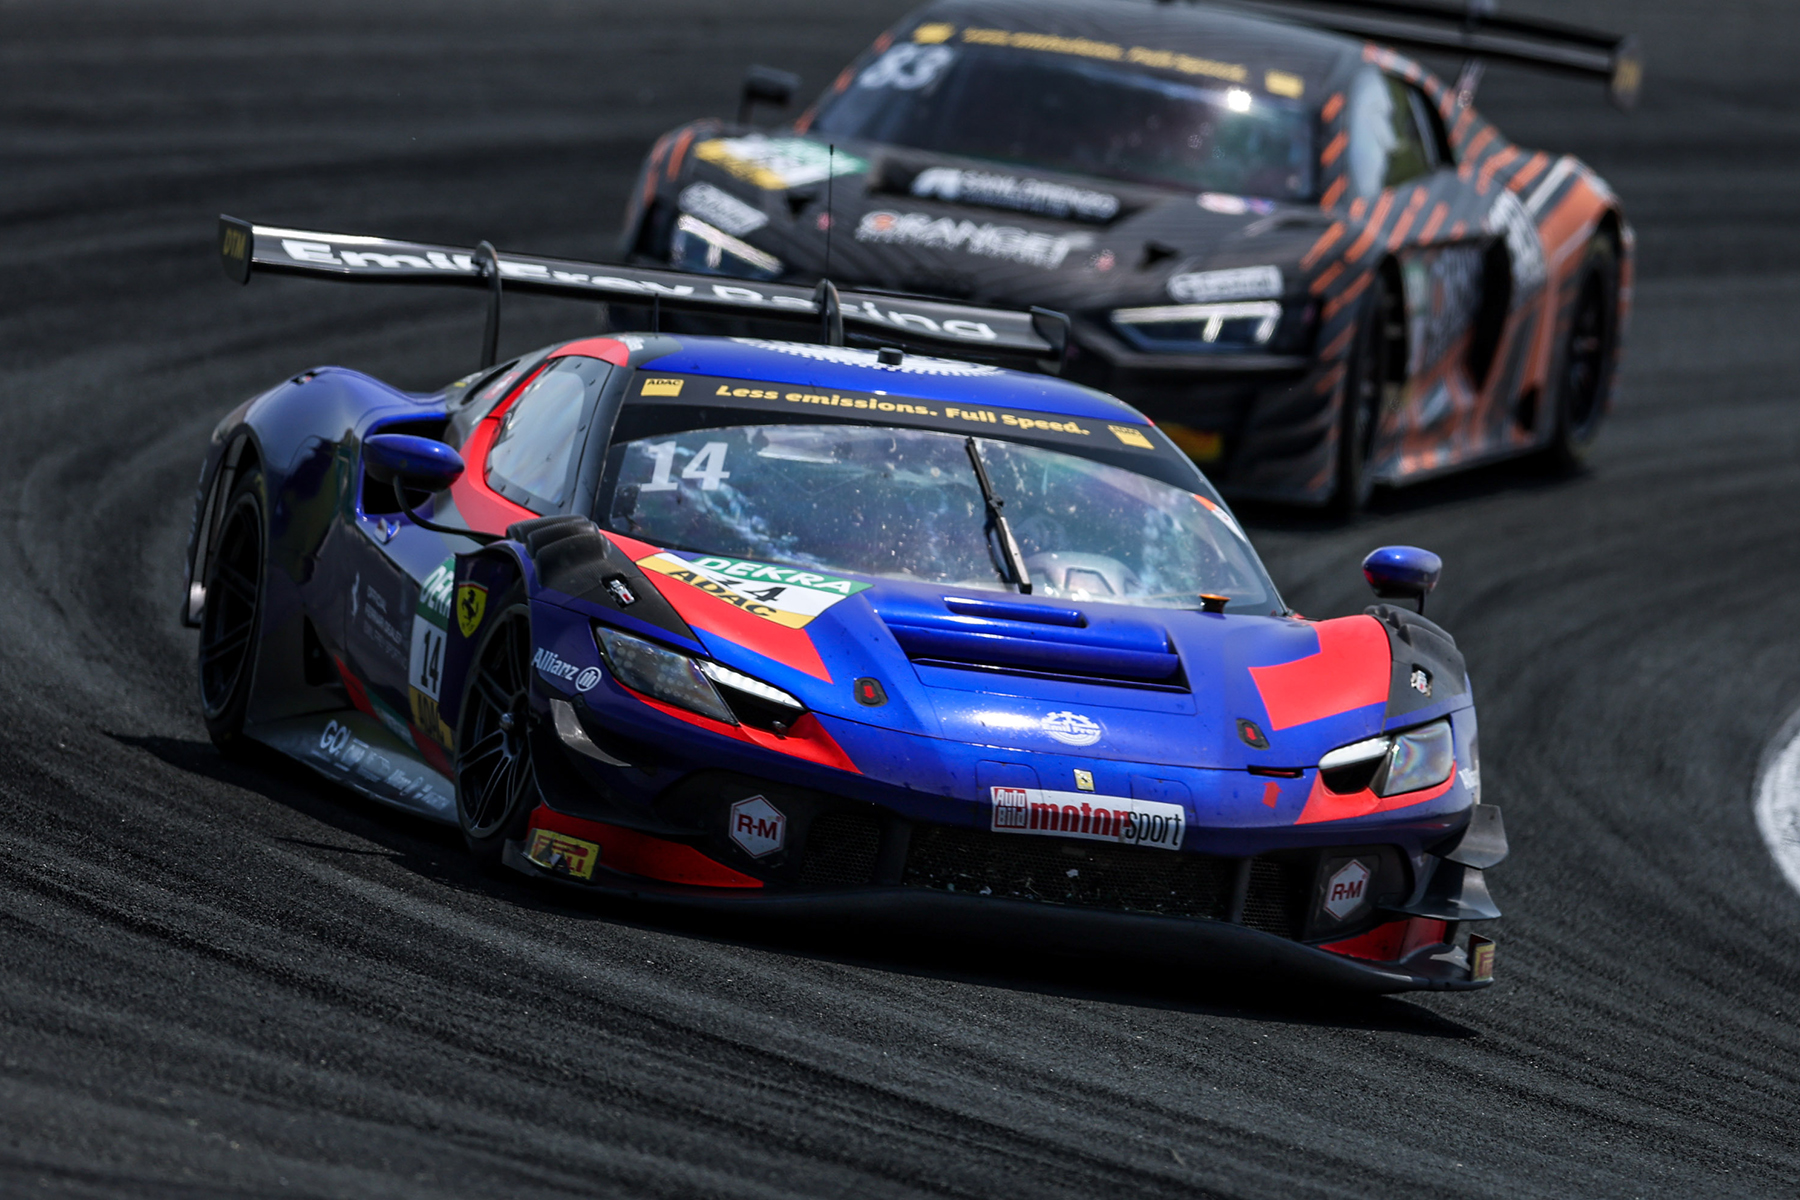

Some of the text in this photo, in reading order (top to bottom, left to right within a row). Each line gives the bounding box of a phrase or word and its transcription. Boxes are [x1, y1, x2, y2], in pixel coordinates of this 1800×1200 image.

[281, 239, 481, 271] Emil
[716, 385, 1090, 435] Less emissions. Full Speed.
[640, 441, 730, 492] 14
[694, 557, 852, 594] DEKRA
[669, 570, 777, 617] ADAC
[421, 630, 442, 694] 14
[531, 647, 580, 681] Allianz
[995, 789, 1027, 808] Auto
[737, 813, 777, 840] R-M
[996, 806, 1027, 827] Bild
[1331, 880, 1363, 901] R-M
